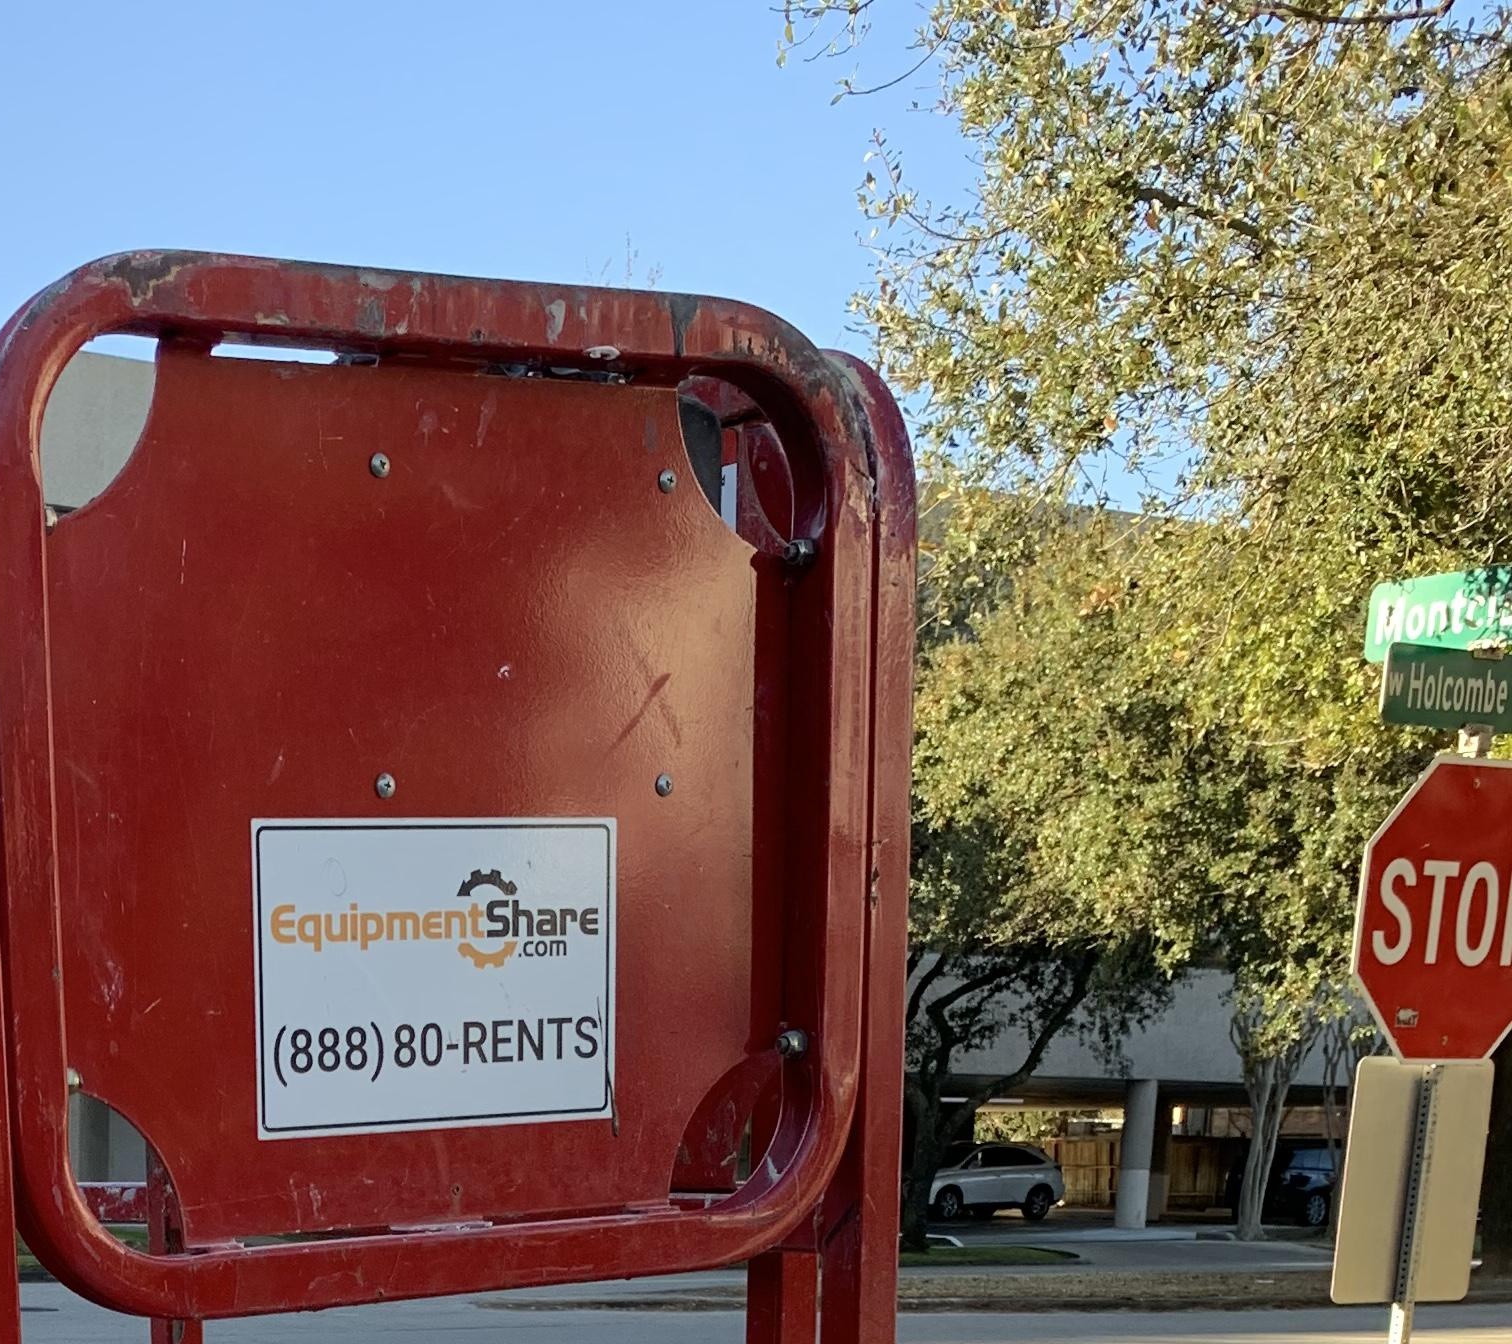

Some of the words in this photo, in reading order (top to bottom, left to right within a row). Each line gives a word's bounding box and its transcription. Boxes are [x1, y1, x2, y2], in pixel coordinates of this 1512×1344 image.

[1407, 662, 1508, 714] Holcombe
[270, 899, 599, 952] EquipmentShare
[517, 939, 567, 958] .com
